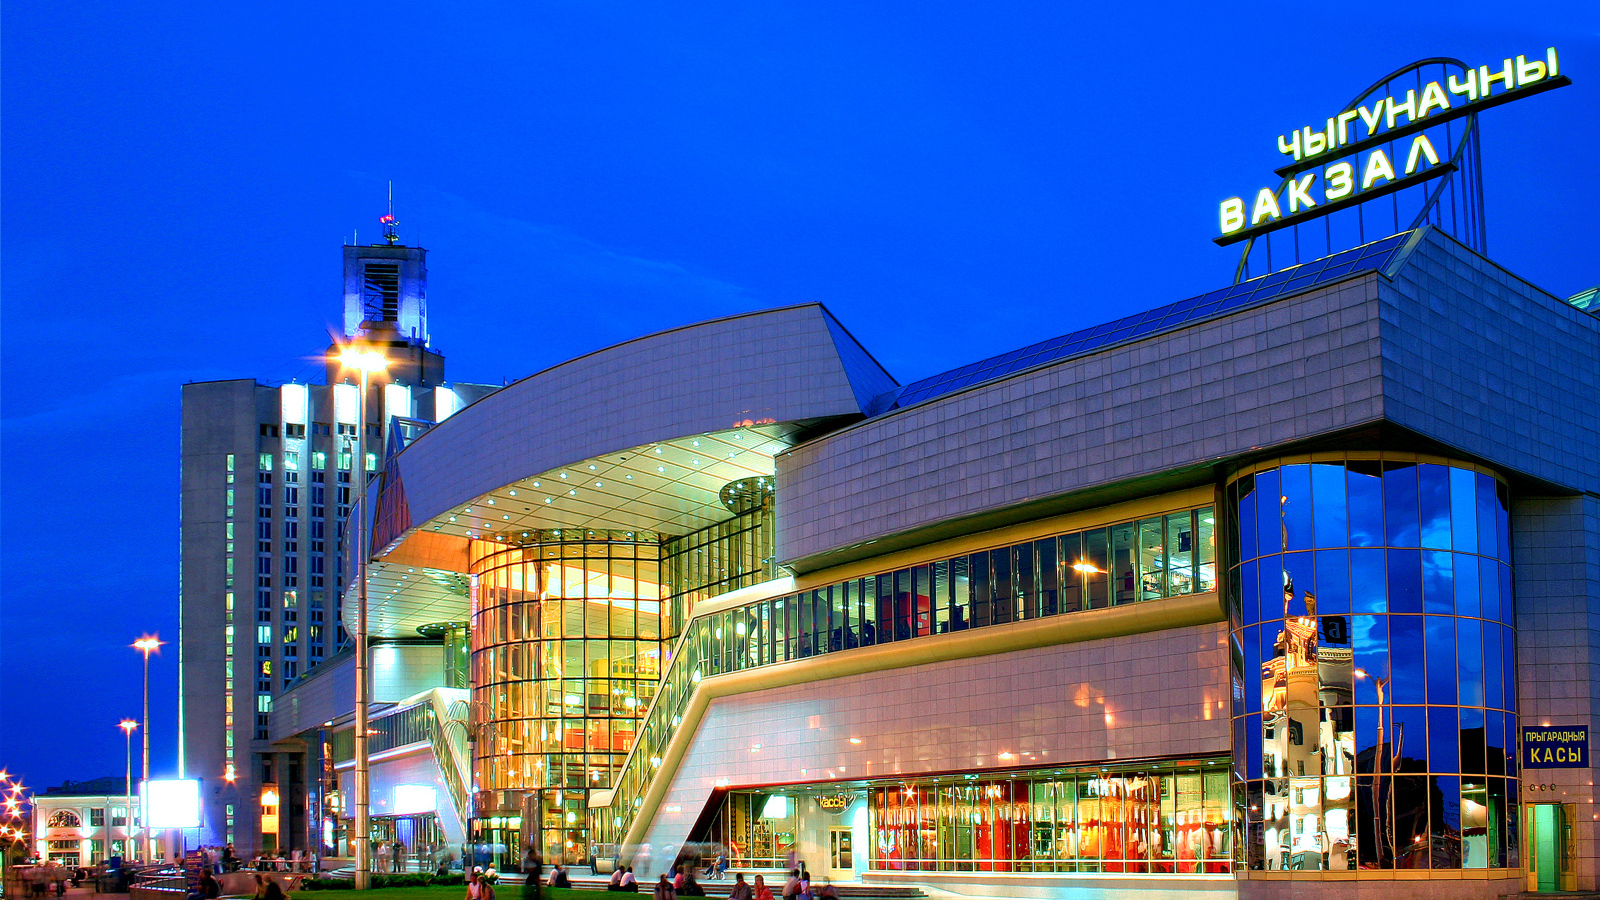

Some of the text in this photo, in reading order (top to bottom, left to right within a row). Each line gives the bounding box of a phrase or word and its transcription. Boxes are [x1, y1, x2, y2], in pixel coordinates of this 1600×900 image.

[1277, 47, 1558, 161] ЧЫГУНАЧНЫ
[1219, 135, 1440, 234] ВАКЗАЛ
[1525, 731, 1585, 743] ПРЫГАРАДНЫЯ
[1531, 747, 1581, 763] КАСЫ
